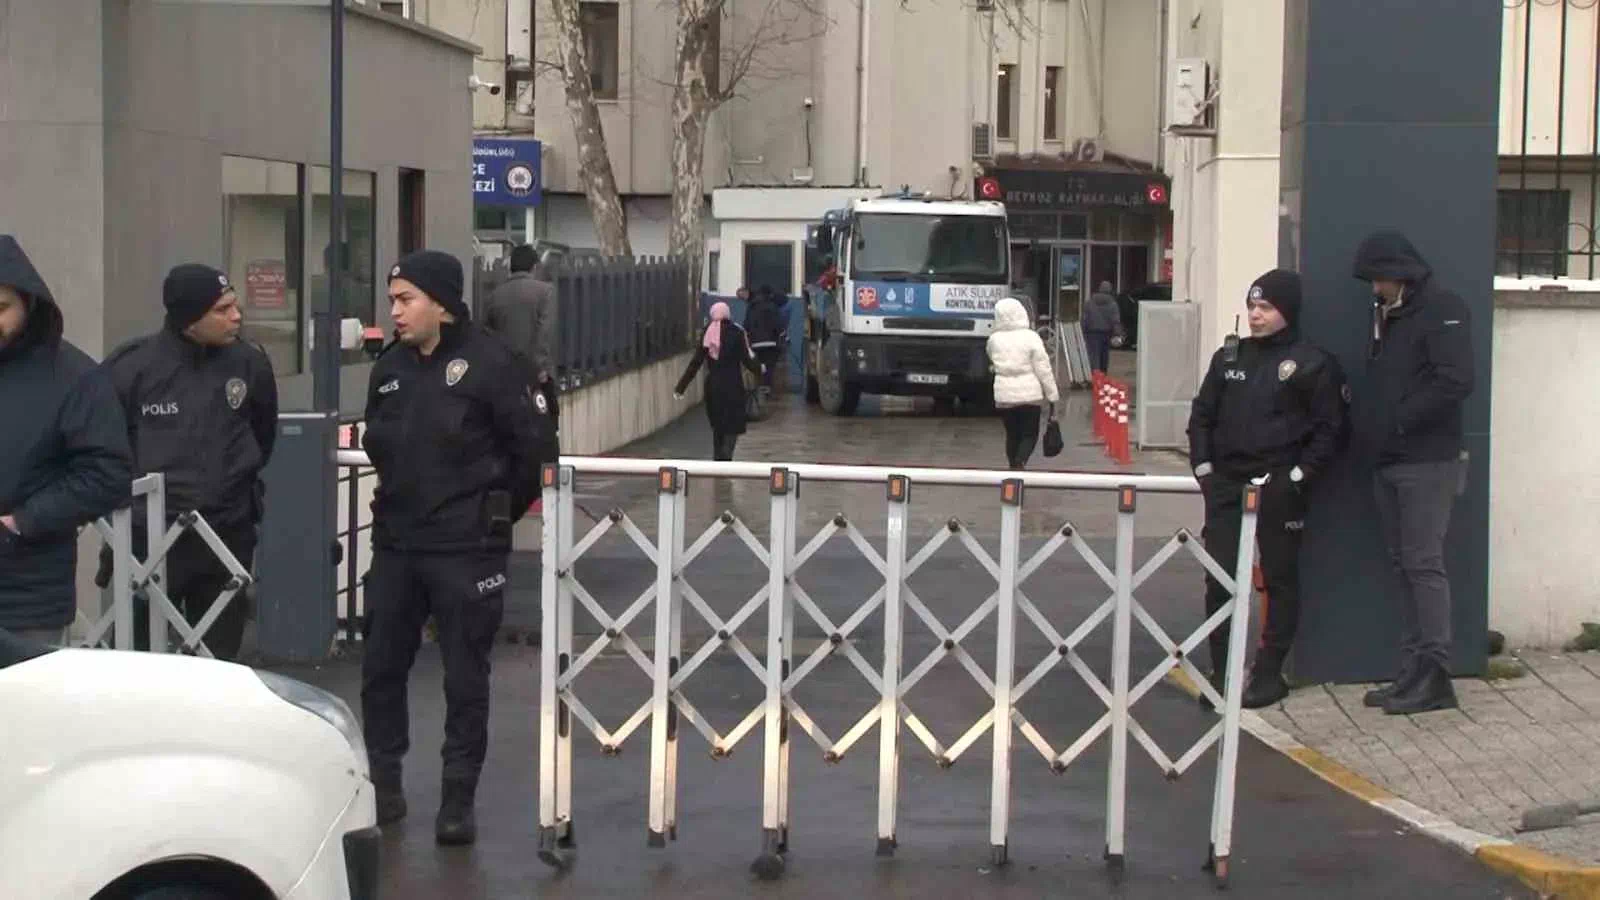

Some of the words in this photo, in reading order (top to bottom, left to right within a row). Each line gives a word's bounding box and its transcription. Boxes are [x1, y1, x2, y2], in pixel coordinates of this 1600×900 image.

[472, 177, 495, 192] EZİ
[945, 287, 968, 297] ATIK
[970, 287, 1001, 298] SULAR
